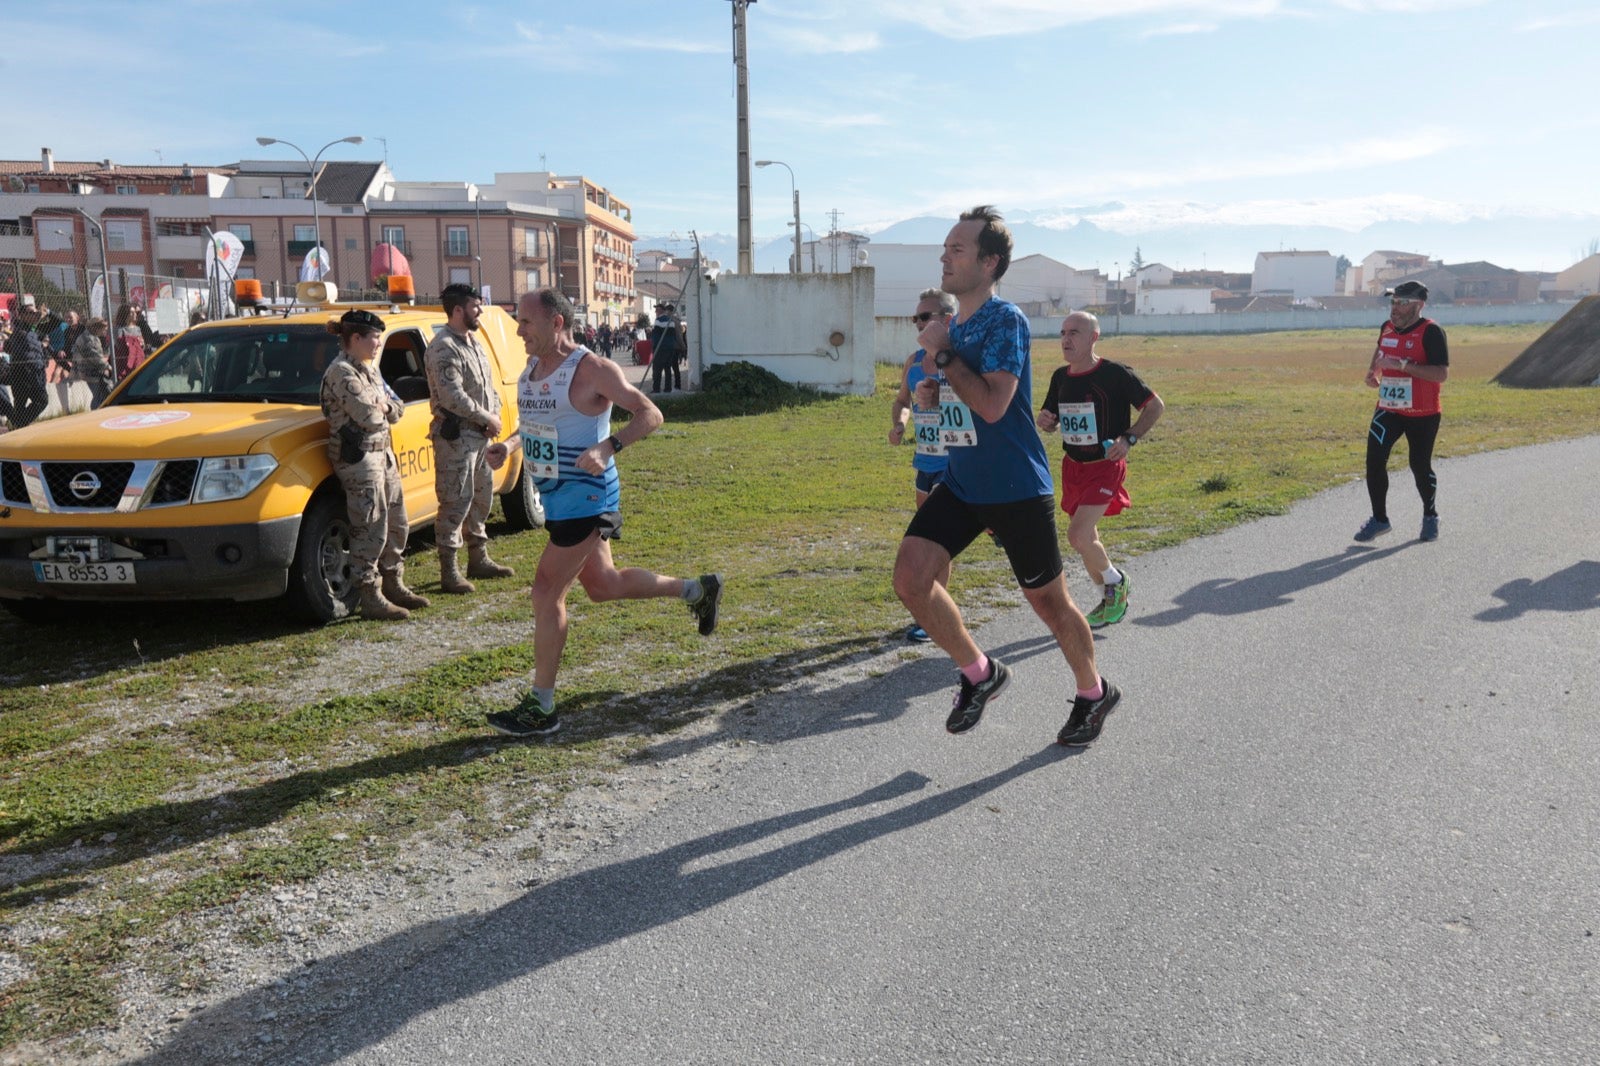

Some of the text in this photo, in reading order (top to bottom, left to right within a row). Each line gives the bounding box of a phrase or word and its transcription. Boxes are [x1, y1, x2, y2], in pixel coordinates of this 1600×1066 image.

[1383, 387, 1405, 399] 742
[1062, 416, 1089, 432] 964
[42, 564, 127, 581] EA 8553 3
